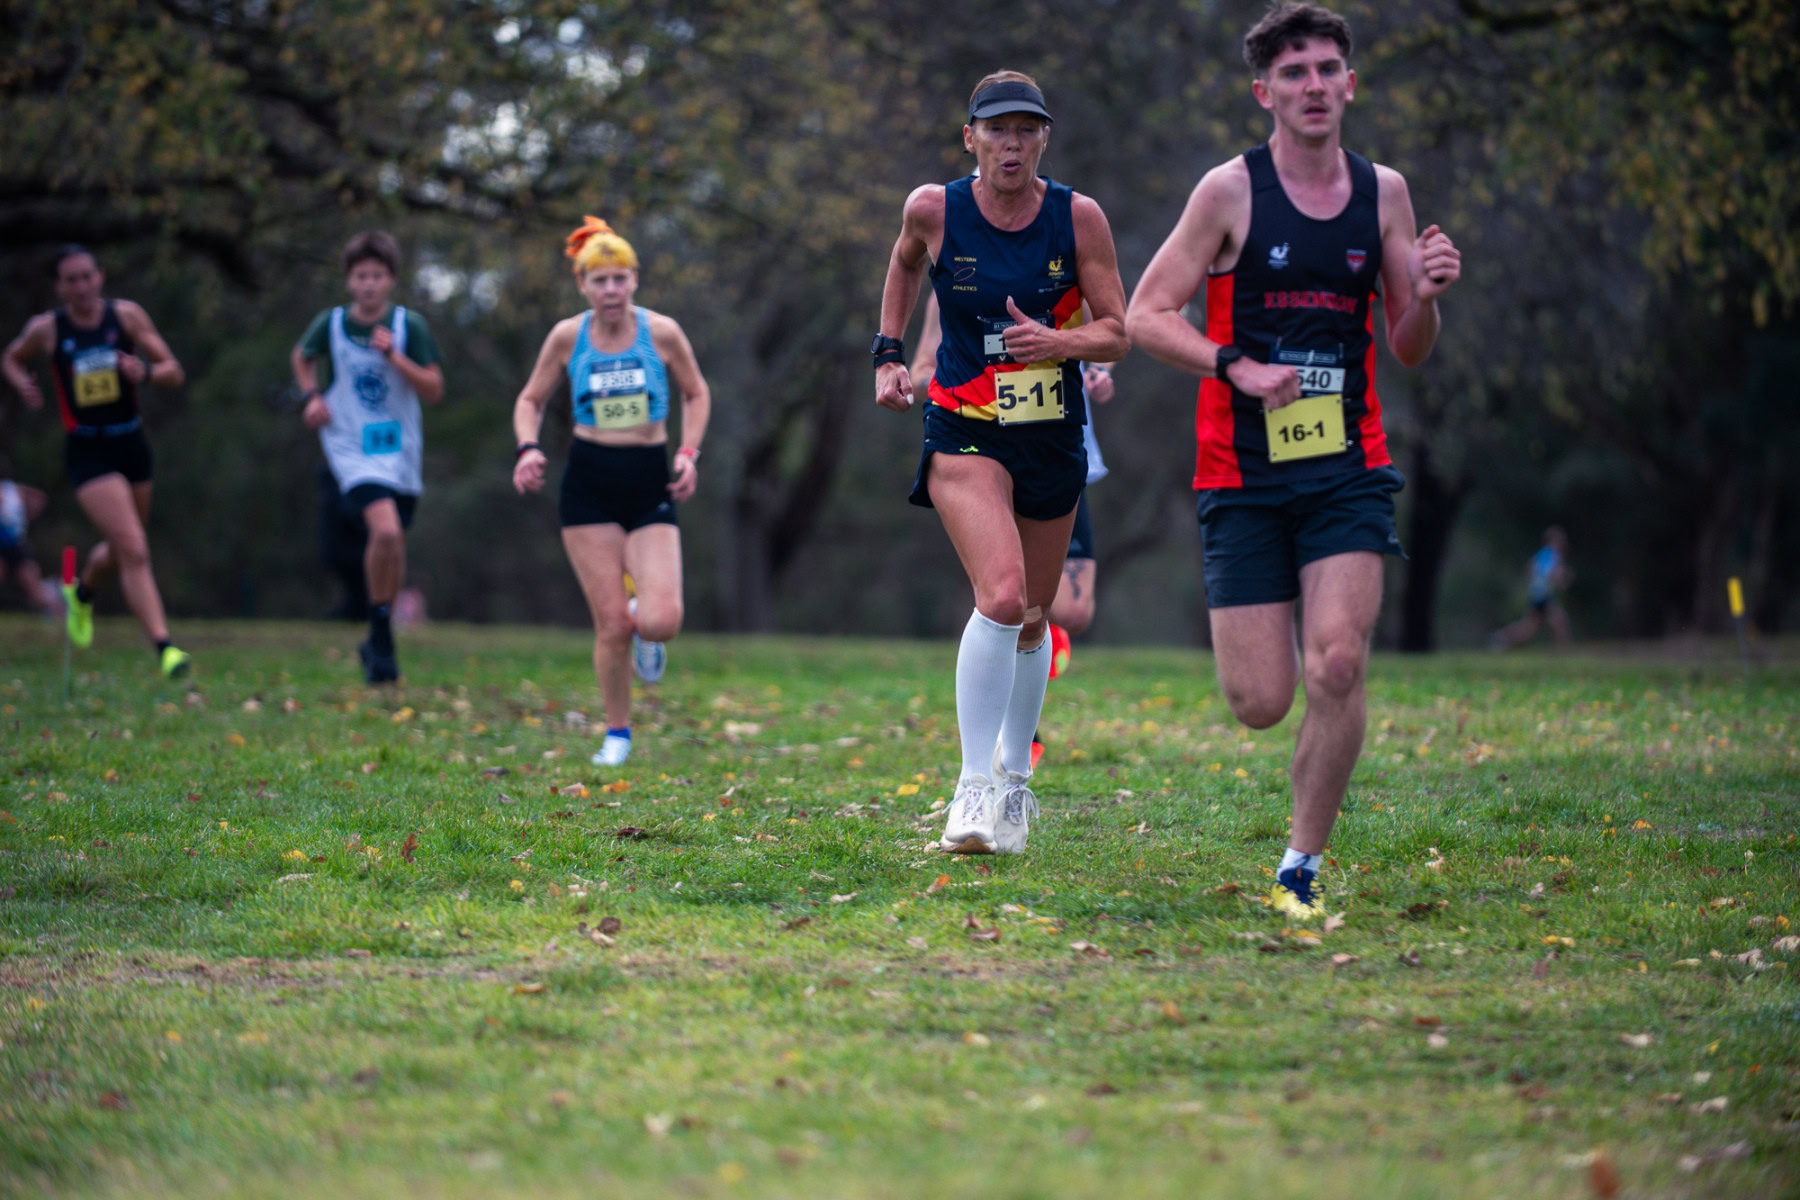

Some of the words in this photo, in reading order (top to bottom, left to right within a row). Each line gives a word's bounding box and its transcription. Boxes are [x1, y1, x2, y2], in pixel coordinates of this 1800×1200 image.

[1265, 292, 1358, 313] ESSENDON
[1296, 370, 1332, 389] 540
[998, 381, 1063, 411] 5-11
[603, 402, 640, 419] 50-5
[1278, 421, 1325, 443] 16-1
